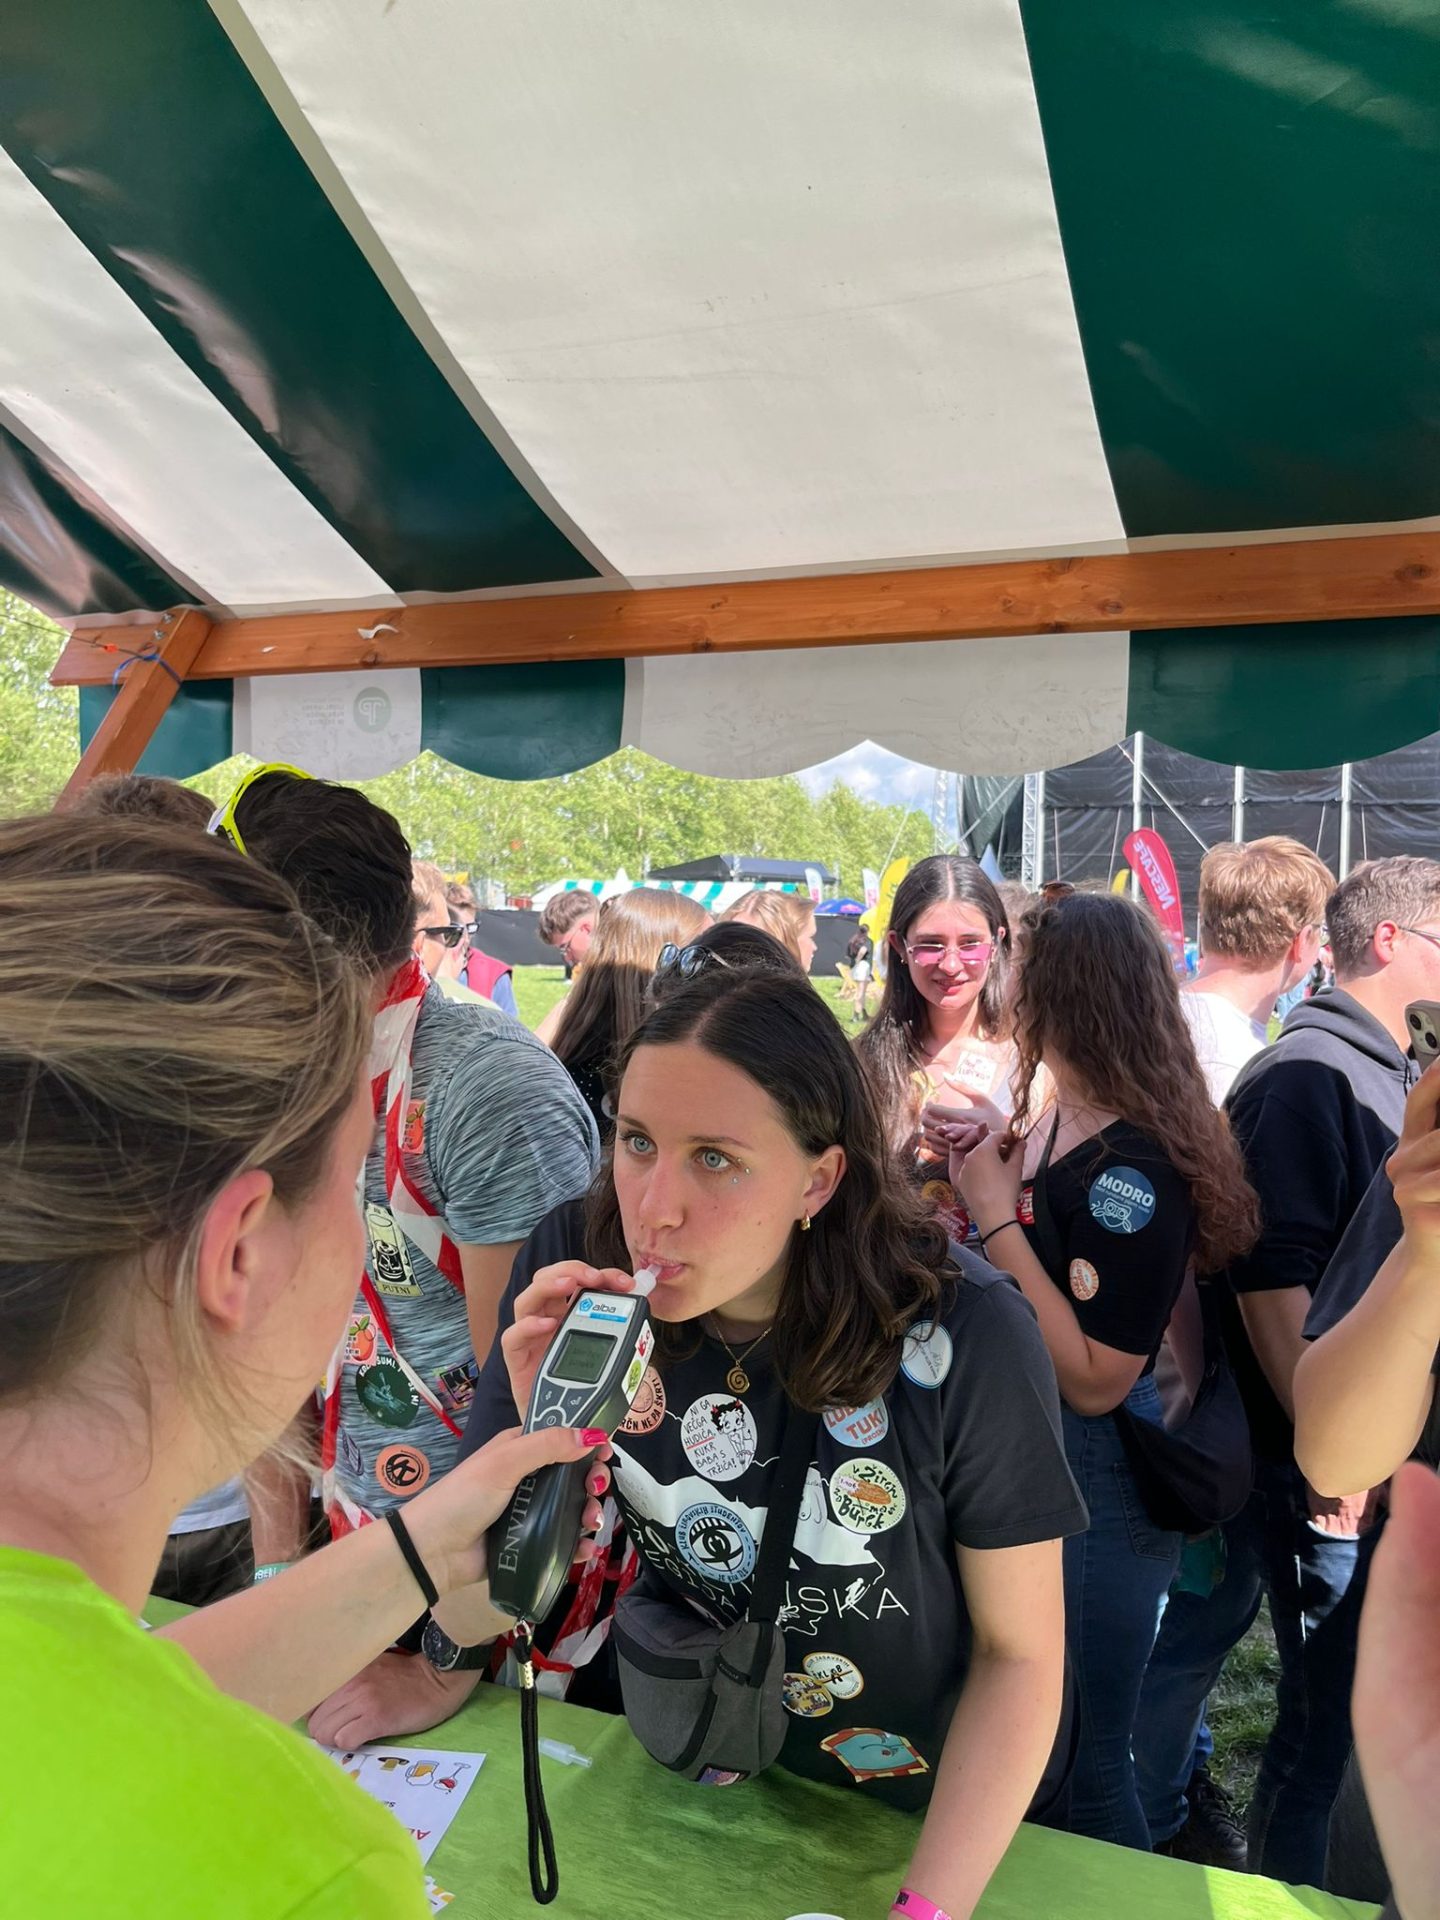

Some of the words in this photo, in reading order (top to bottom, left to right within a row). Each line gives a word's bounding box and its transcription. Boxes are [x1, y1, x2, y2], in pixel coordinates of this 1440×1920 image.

[1098, 1173, 1154, 1207] MODRO
[592, 1304, 616, 1313] alba
[690, 1405, 699, 1417] NI
[700, 1399, 711, 1411] GA
[641, 1417, 654, 1430] NE
[650, 1408, 661, 1421] PA
[683, 1416, 708, 1434] VEČGA
[694, 1442, 717, 1457] KUKR
[696, 1453, 718, 1468] BABA
[707, 1458, 737, 1477] TRŽIČA!
[498, 1476, 538, 1574] ENVITE
